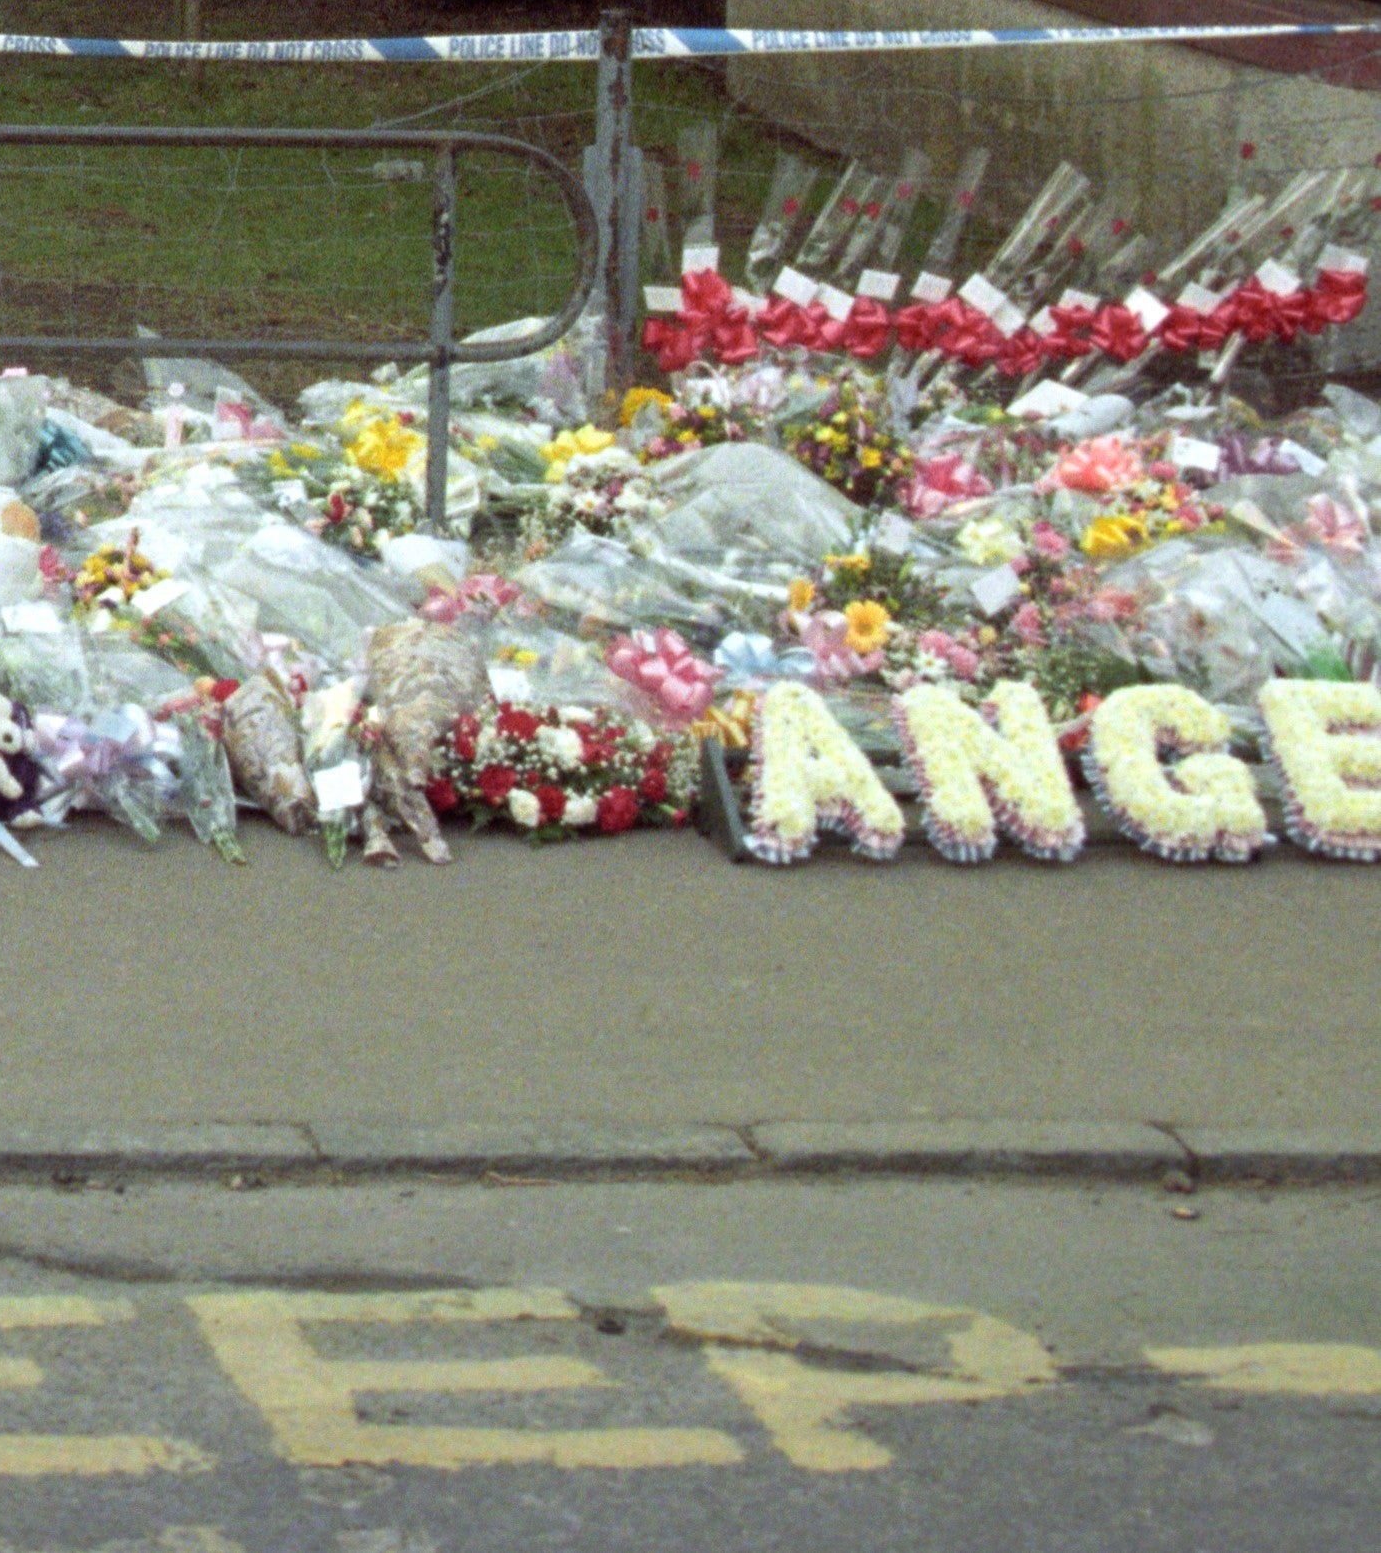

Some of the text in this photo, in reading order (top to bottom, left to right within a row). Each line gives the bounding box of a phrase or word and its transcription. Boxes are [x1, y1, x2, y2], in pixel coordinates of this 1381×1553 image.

[2, 35, 58, 54] CROSS
[144, 40, 364, 60] POLICE LINE DO NOT CROSS
[449, 35, 505, 59] POLICE
[510, 33, 544, 58] LINE
[549, 32, 570, 57] DO
[576, 31, 600, 56] NO
[752, 30, 809, 50] POLICE
[814, 30, 850, 49] LINE
[746, 677, 1381, 861] ANGE
